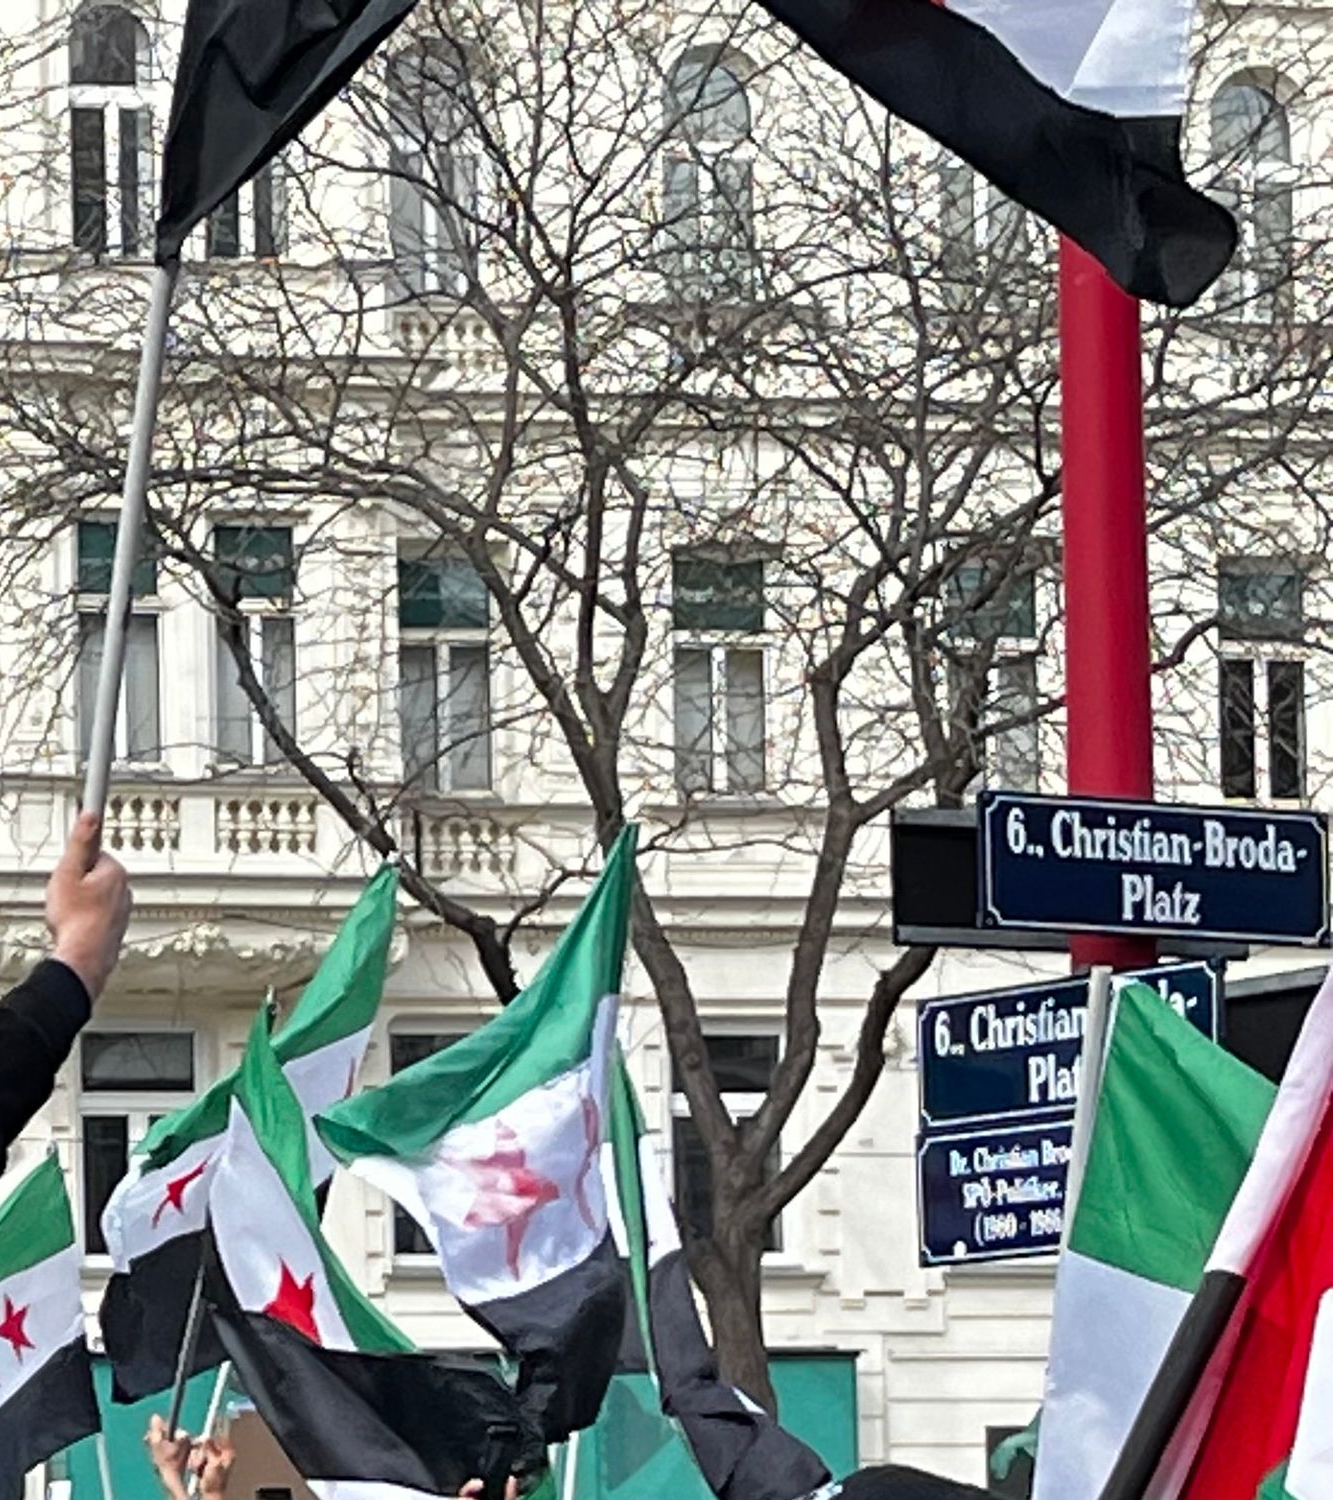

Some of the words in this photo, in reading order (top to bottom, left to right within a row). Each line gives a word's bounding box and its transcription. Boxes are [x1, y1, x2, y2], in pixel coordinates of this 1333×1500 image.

[1006, 806, 1044, 858] 6.,
[1050, 808, 1308, 873] Christian-Broda-
[1121, 873, 1202, 924] Platz
[1028, 1053, 1082, 1103] Plat
[949, 1150, 971, 1176] Dr.
[973, 1144, 1039, 1172] Christian
